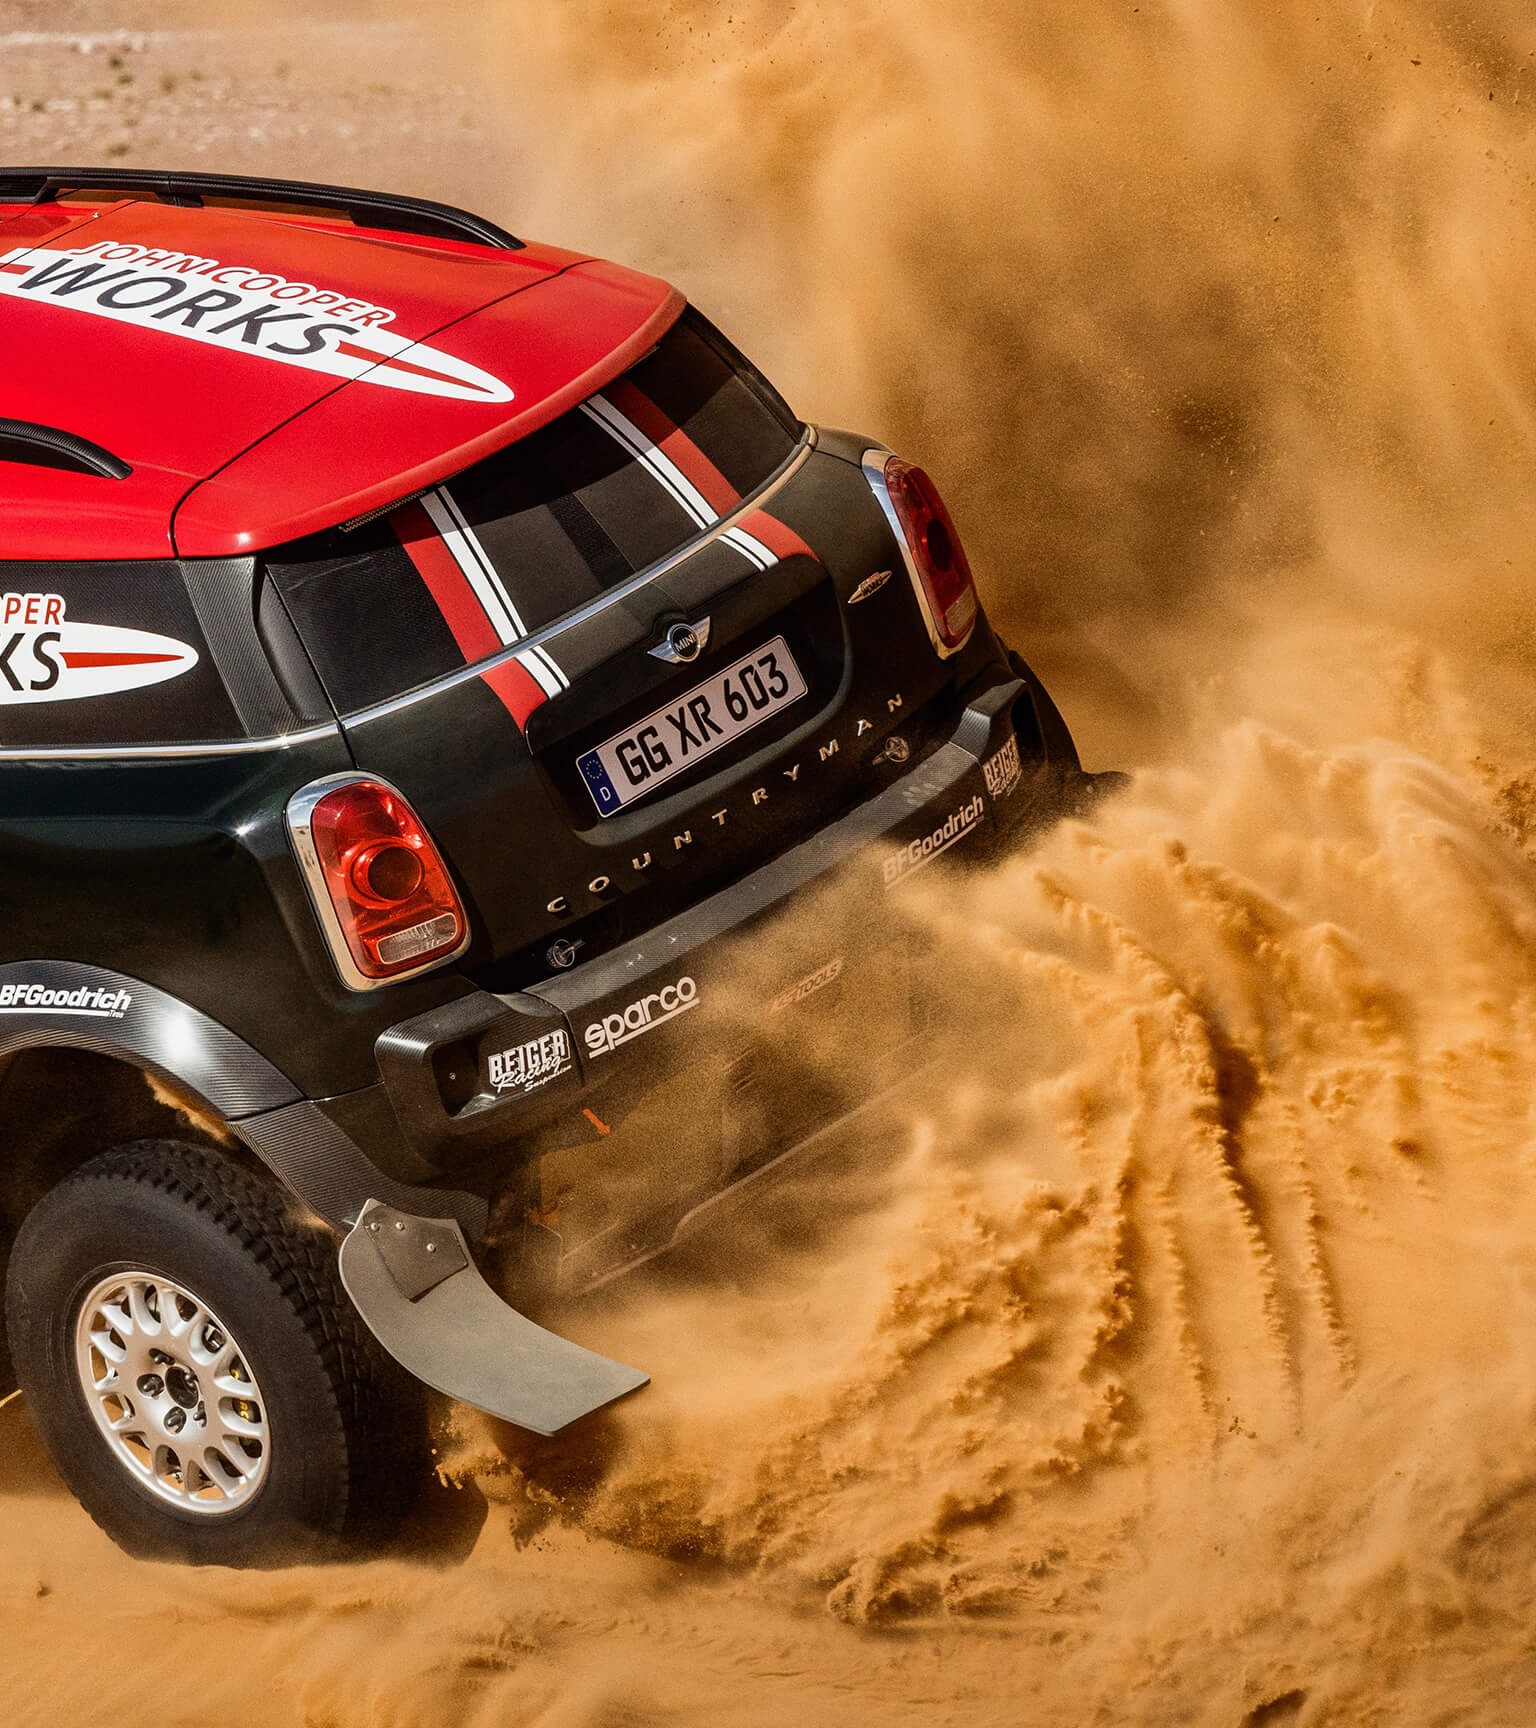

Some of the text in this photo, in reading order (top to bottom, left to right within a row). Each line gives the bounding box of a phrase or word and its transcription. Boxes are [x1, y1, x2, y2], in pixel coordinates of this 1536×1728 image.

[18, 257, 360, 356] WORKS
[70, 243, 391, 328] JOHN COOPER
[675, 633, 697, 652] MINI
[615, 652, 789, 786] GG XR 603
[546, 693, 904, 914] COUNTRYMAN
[599, 786, 612, 802] D
[882, 794, 984, 884] BFGoodrich
[584, 976, 697, 1051] sparco
[496, 1055, 563, 1094] Racing
